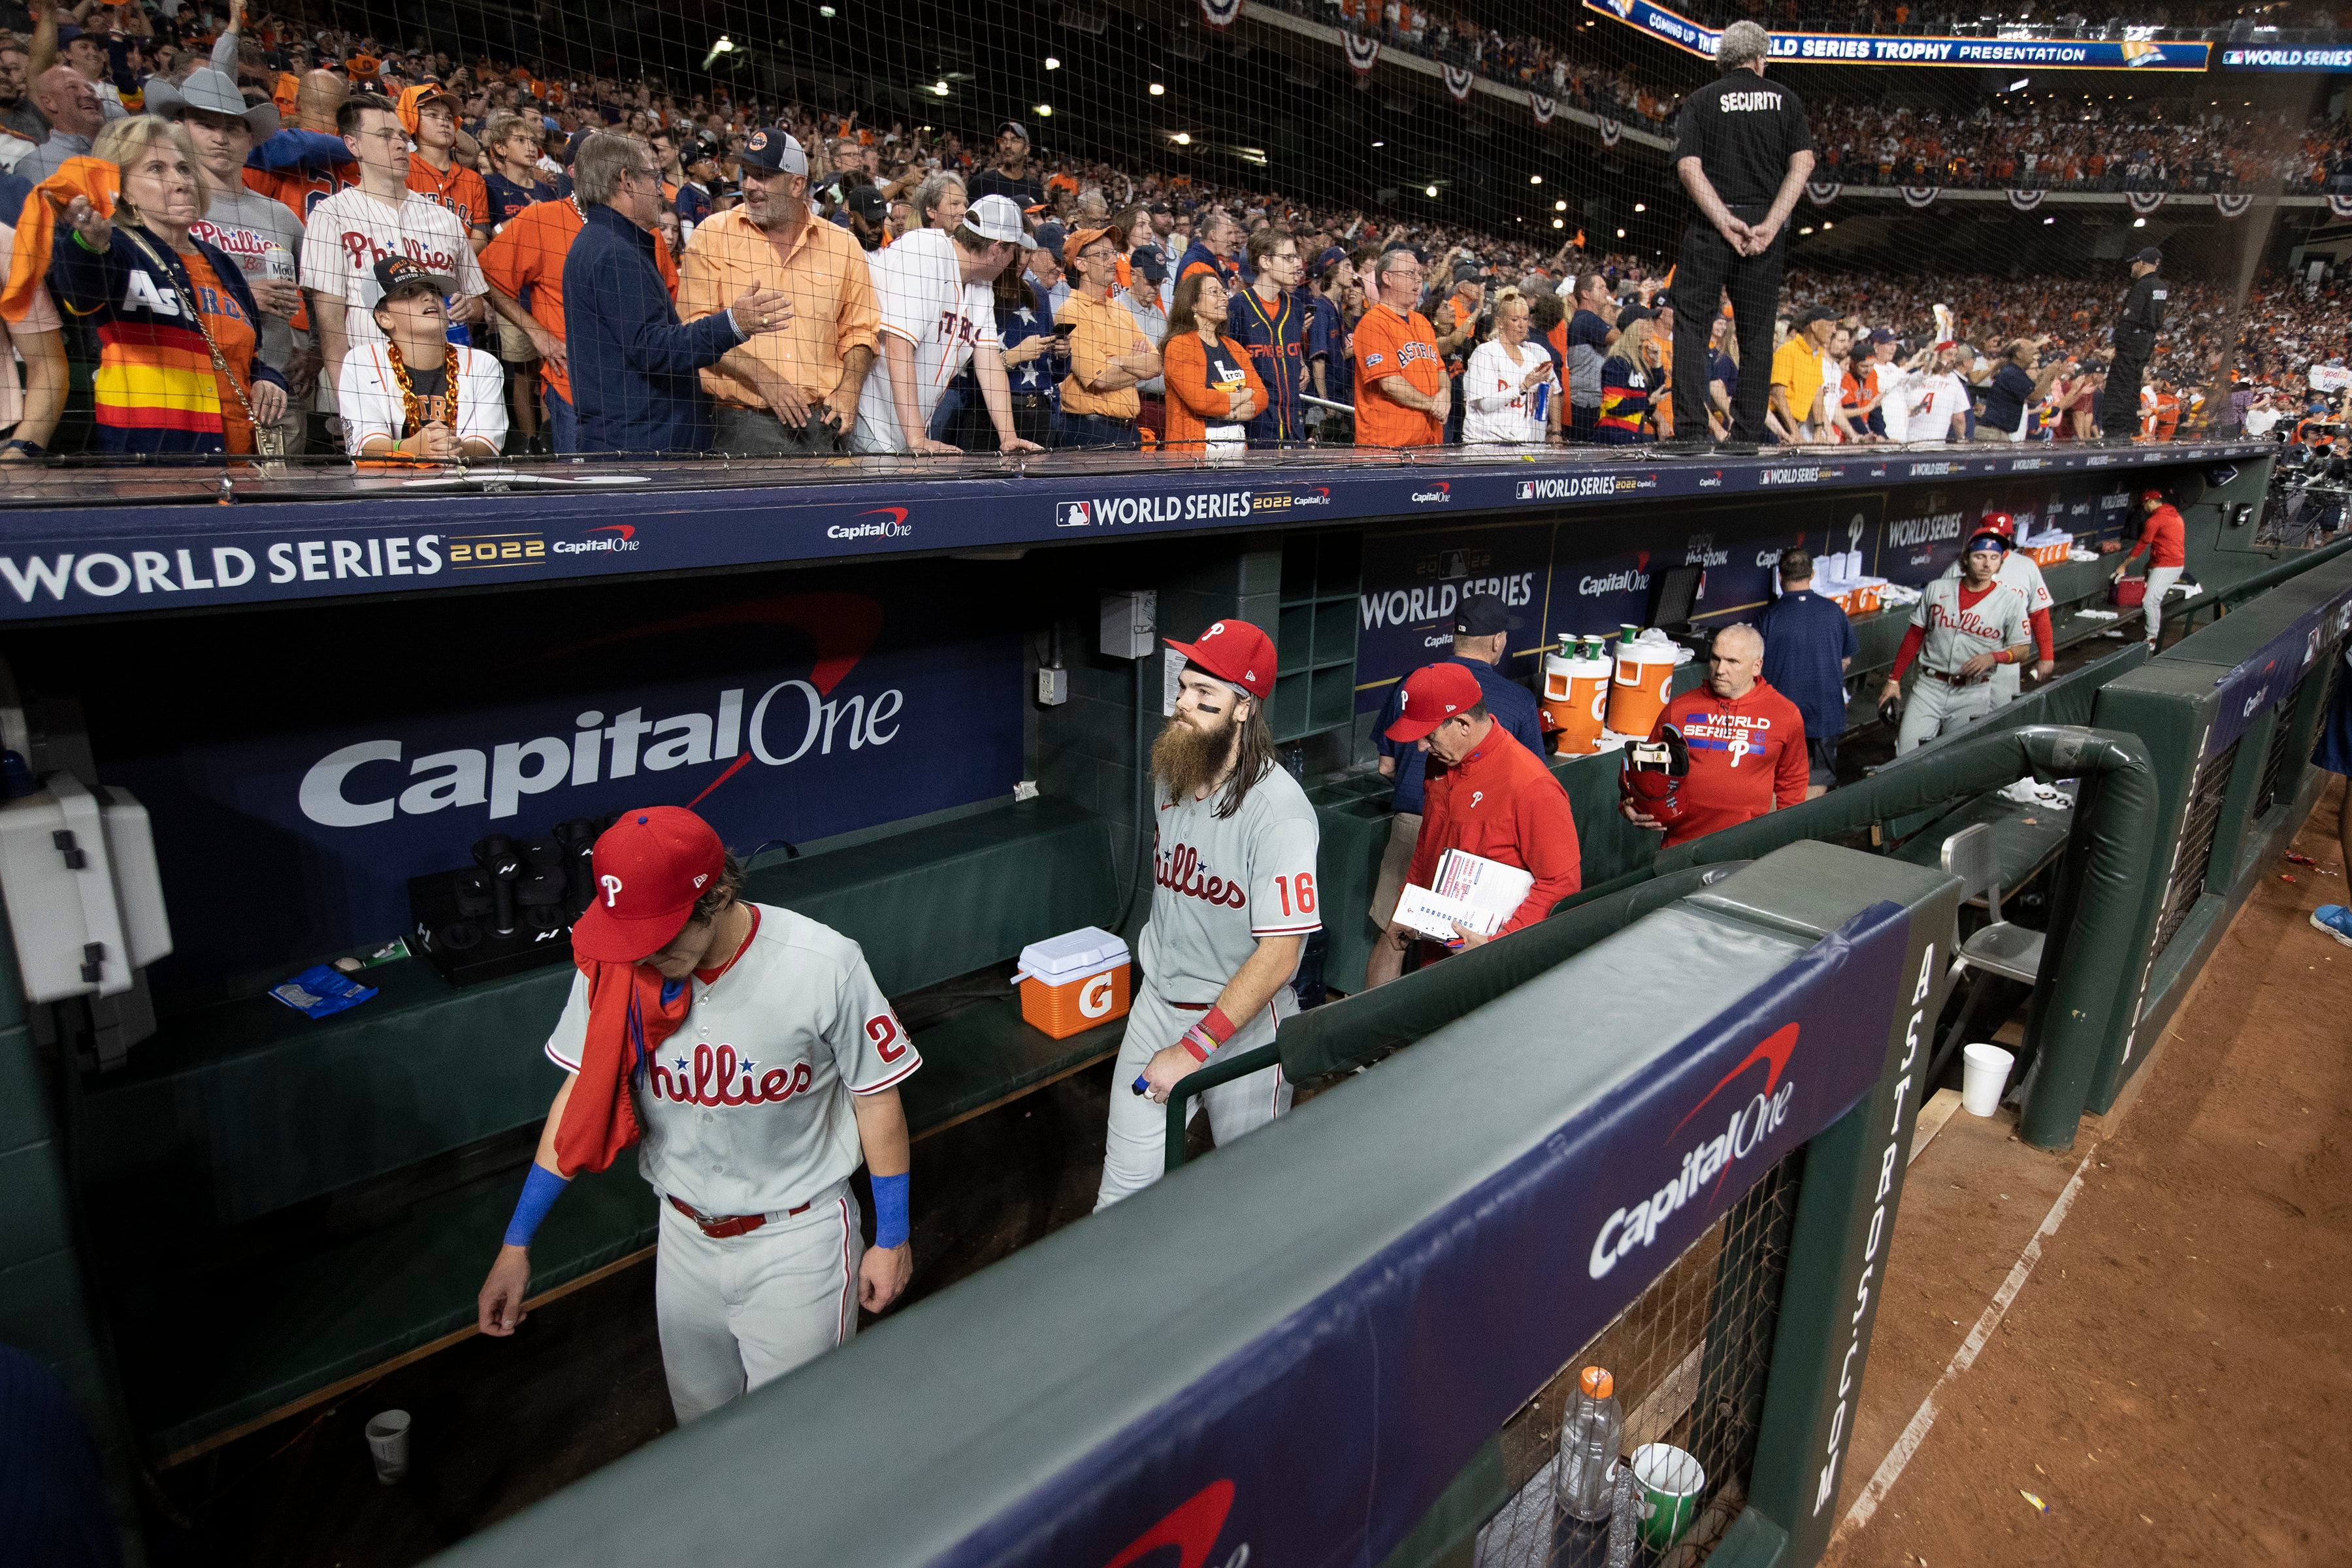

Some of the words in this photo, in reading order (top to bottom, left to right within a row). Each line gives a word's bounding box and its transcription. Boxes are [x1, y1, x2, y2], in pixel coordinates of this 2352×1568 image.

[1649, 12, 1682, 39] COMING
[1683, 29, 1696, 43] UP
[1699, 33, 1721, 54] THE
[1802, 39, 1870, 57] SERIES
[1874, 41, 1953, 61] TROPHY
[1959, 46, 2086, 62] PRESENTATION
[2244, 50, 2302, 65] WORLD
[2302, 50, 2352, 67] SERIES
[1720, 91, 1782, 113] SECURITY
[189, 220, 281, 255] Phillie
[1535, 479, 1578, 498] WORLD
[1580, 476, 1616, 495] SERIES
[1616, 480, 1636, 489] 2022
[1771, 469, 1797, 484] WORLD
[1797, 467, 1819, 482] SERIES
[1093, 497, 1181, 526] WORLD
[1185, 491, 1251, 520] SERIES
[1253, 496, 1292, 509] 2022
[1889, 517, 1929, 549] WORLD
[1929, 512, 1963, 540] SERIES
[0, 546, 256, 602] WORLD
[268, 534, 443, 583] SERIES
[449, 540, 546, 562] 2022
[1685, 550, 1702, 566] the
[1360, 584, 1457, 630] WORLD
[1462, 572, 1533, 607] SERIES
[2037, 587, 2048, 601] 9
[1201, 623, 1225, 642] P
[1930, 603, 2001, 639] Phillies
[1424, 634, 1453, 648] Capita
[1683, 725, 1749, 741] SERIES
[1707, 713, 1771, 730] WORLD
[1728, 740, 1750, 768] P
[1470, 790, 1484, 808] P
[1154, 823, 1247, 909] hillies
[601, 874, 623, 907] P
[1274, 871, 1316, 917] 16
[1079, 972, 1113, 1019] G
[651, 1042, 812, 1107] hillies
[1813, 942, 1935, 1518] ASTROS.COM
